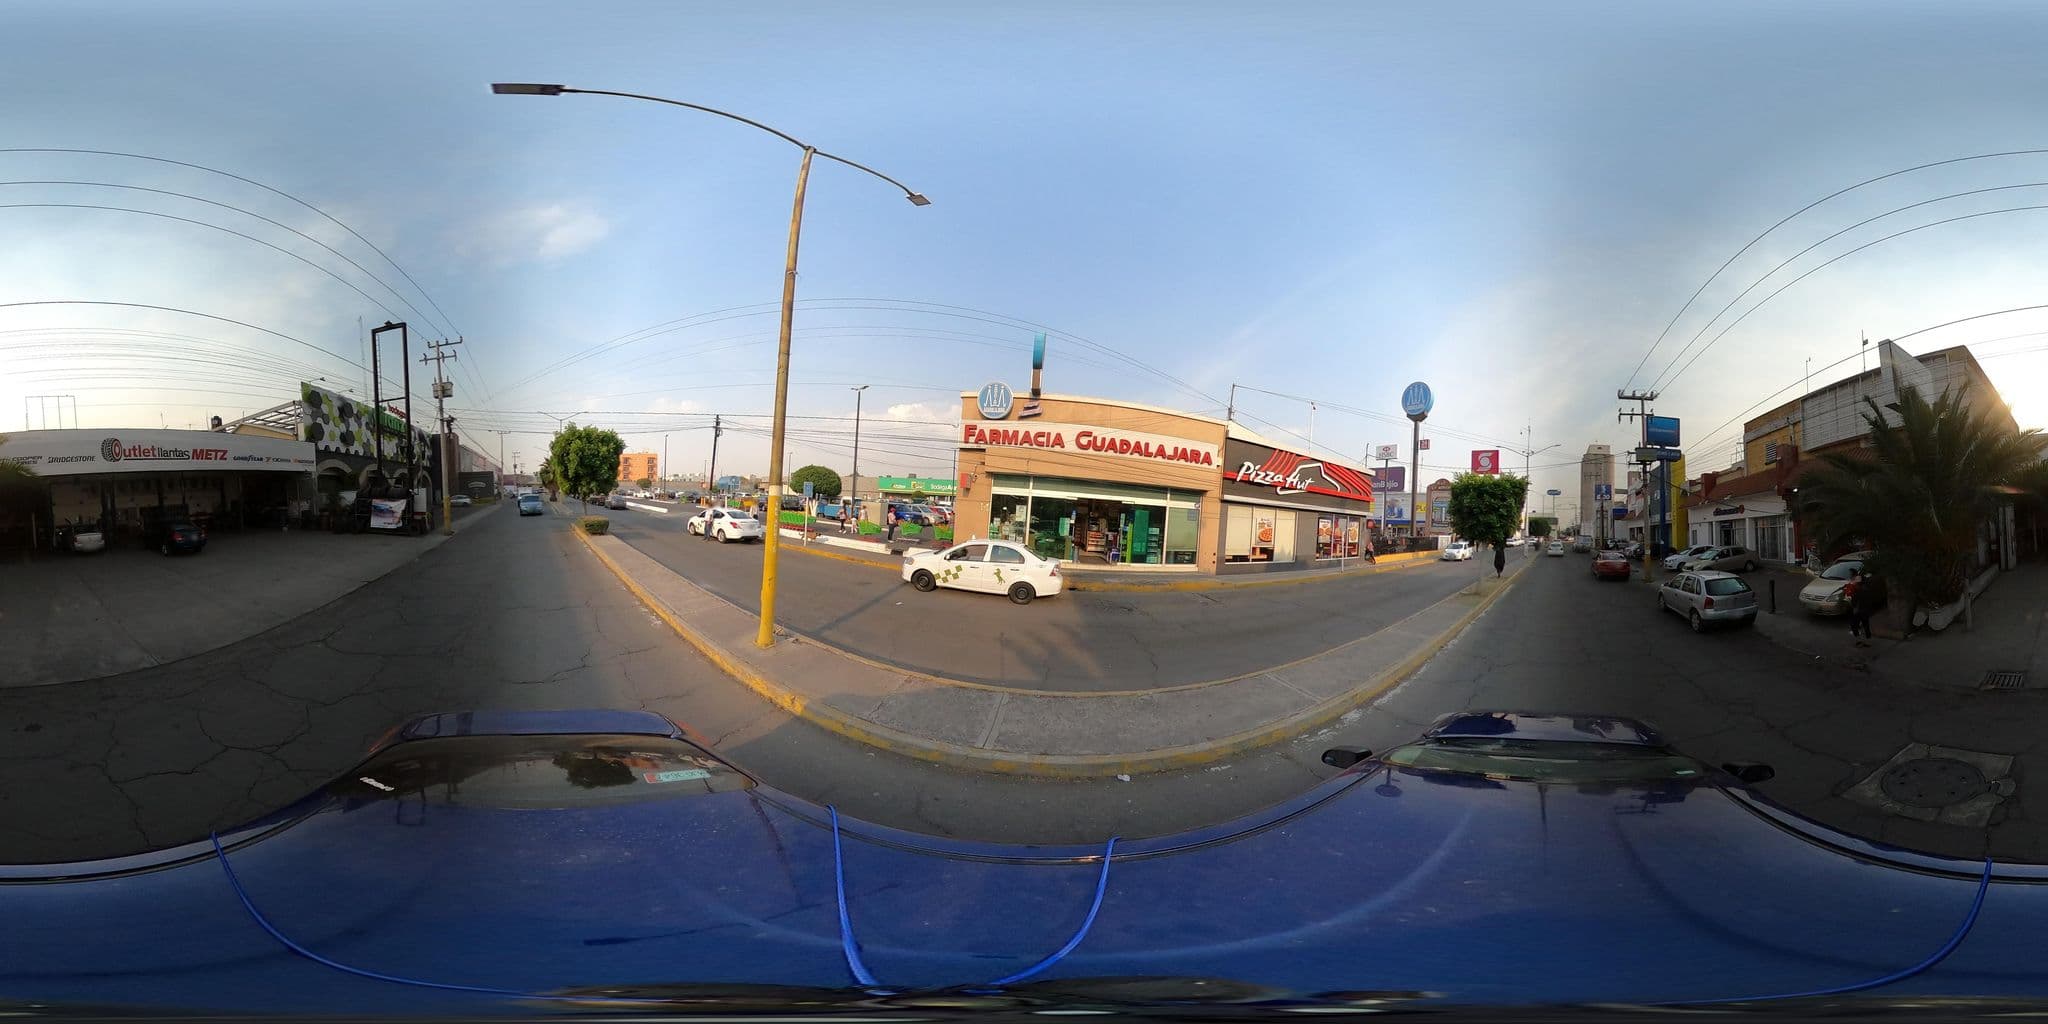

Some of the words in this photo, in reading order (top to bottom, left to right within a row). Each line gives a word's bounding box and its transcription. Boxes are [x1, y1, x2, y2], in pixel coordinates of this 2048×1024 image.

[191, 448, 228, 461] METZ
[963, 424, 1065, 449] FARMACIA
[1075, 430, 1213, 466] GUADALAJARA
[47, 455, 97, 464] BRIDGESTONE
[1236, 461, 1284, 485] Pizza
[1285, 473, 1315, 490] Hut
